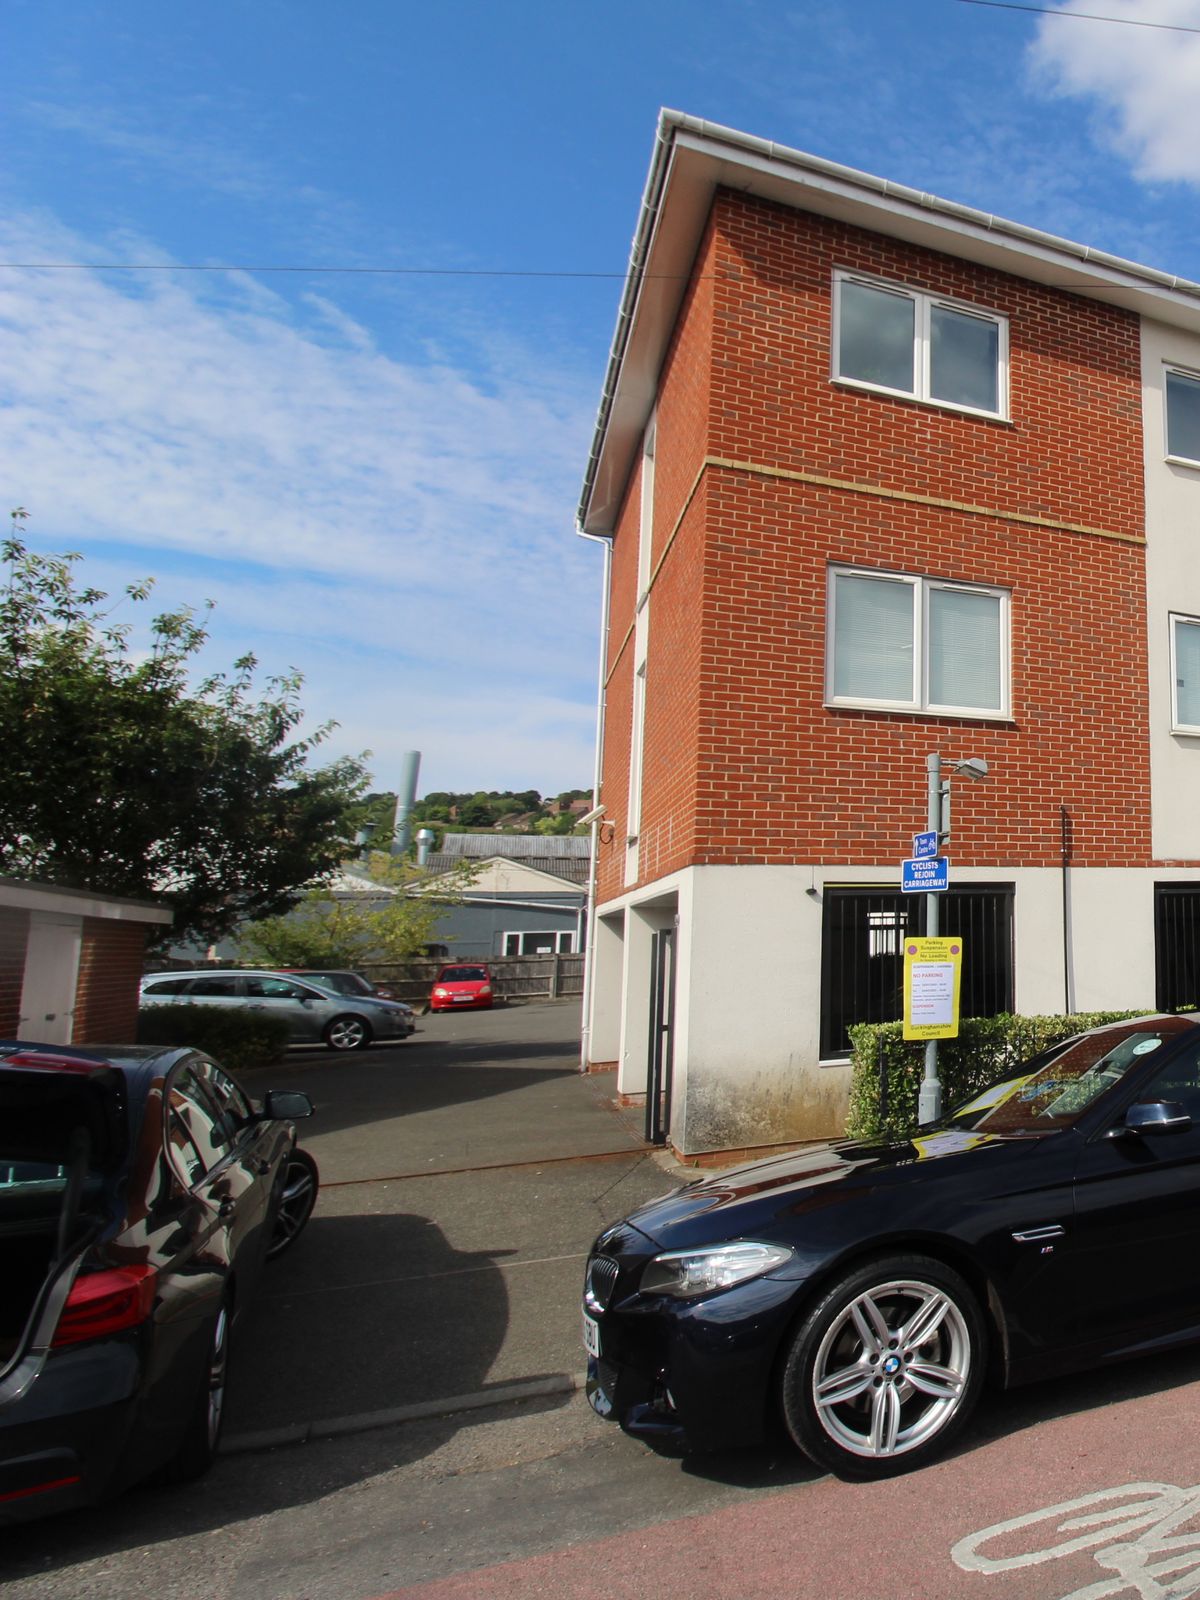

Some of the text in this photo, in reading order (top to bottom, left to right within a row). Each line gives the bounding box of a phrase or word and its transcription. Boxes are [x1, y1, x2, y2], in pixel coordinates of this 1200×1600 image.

[911, 861, 939, 871] CYCLISTS
[914, 870, 936, 879] REJOIN
[903, 879, 946, 888] CARRIAGEWAY
